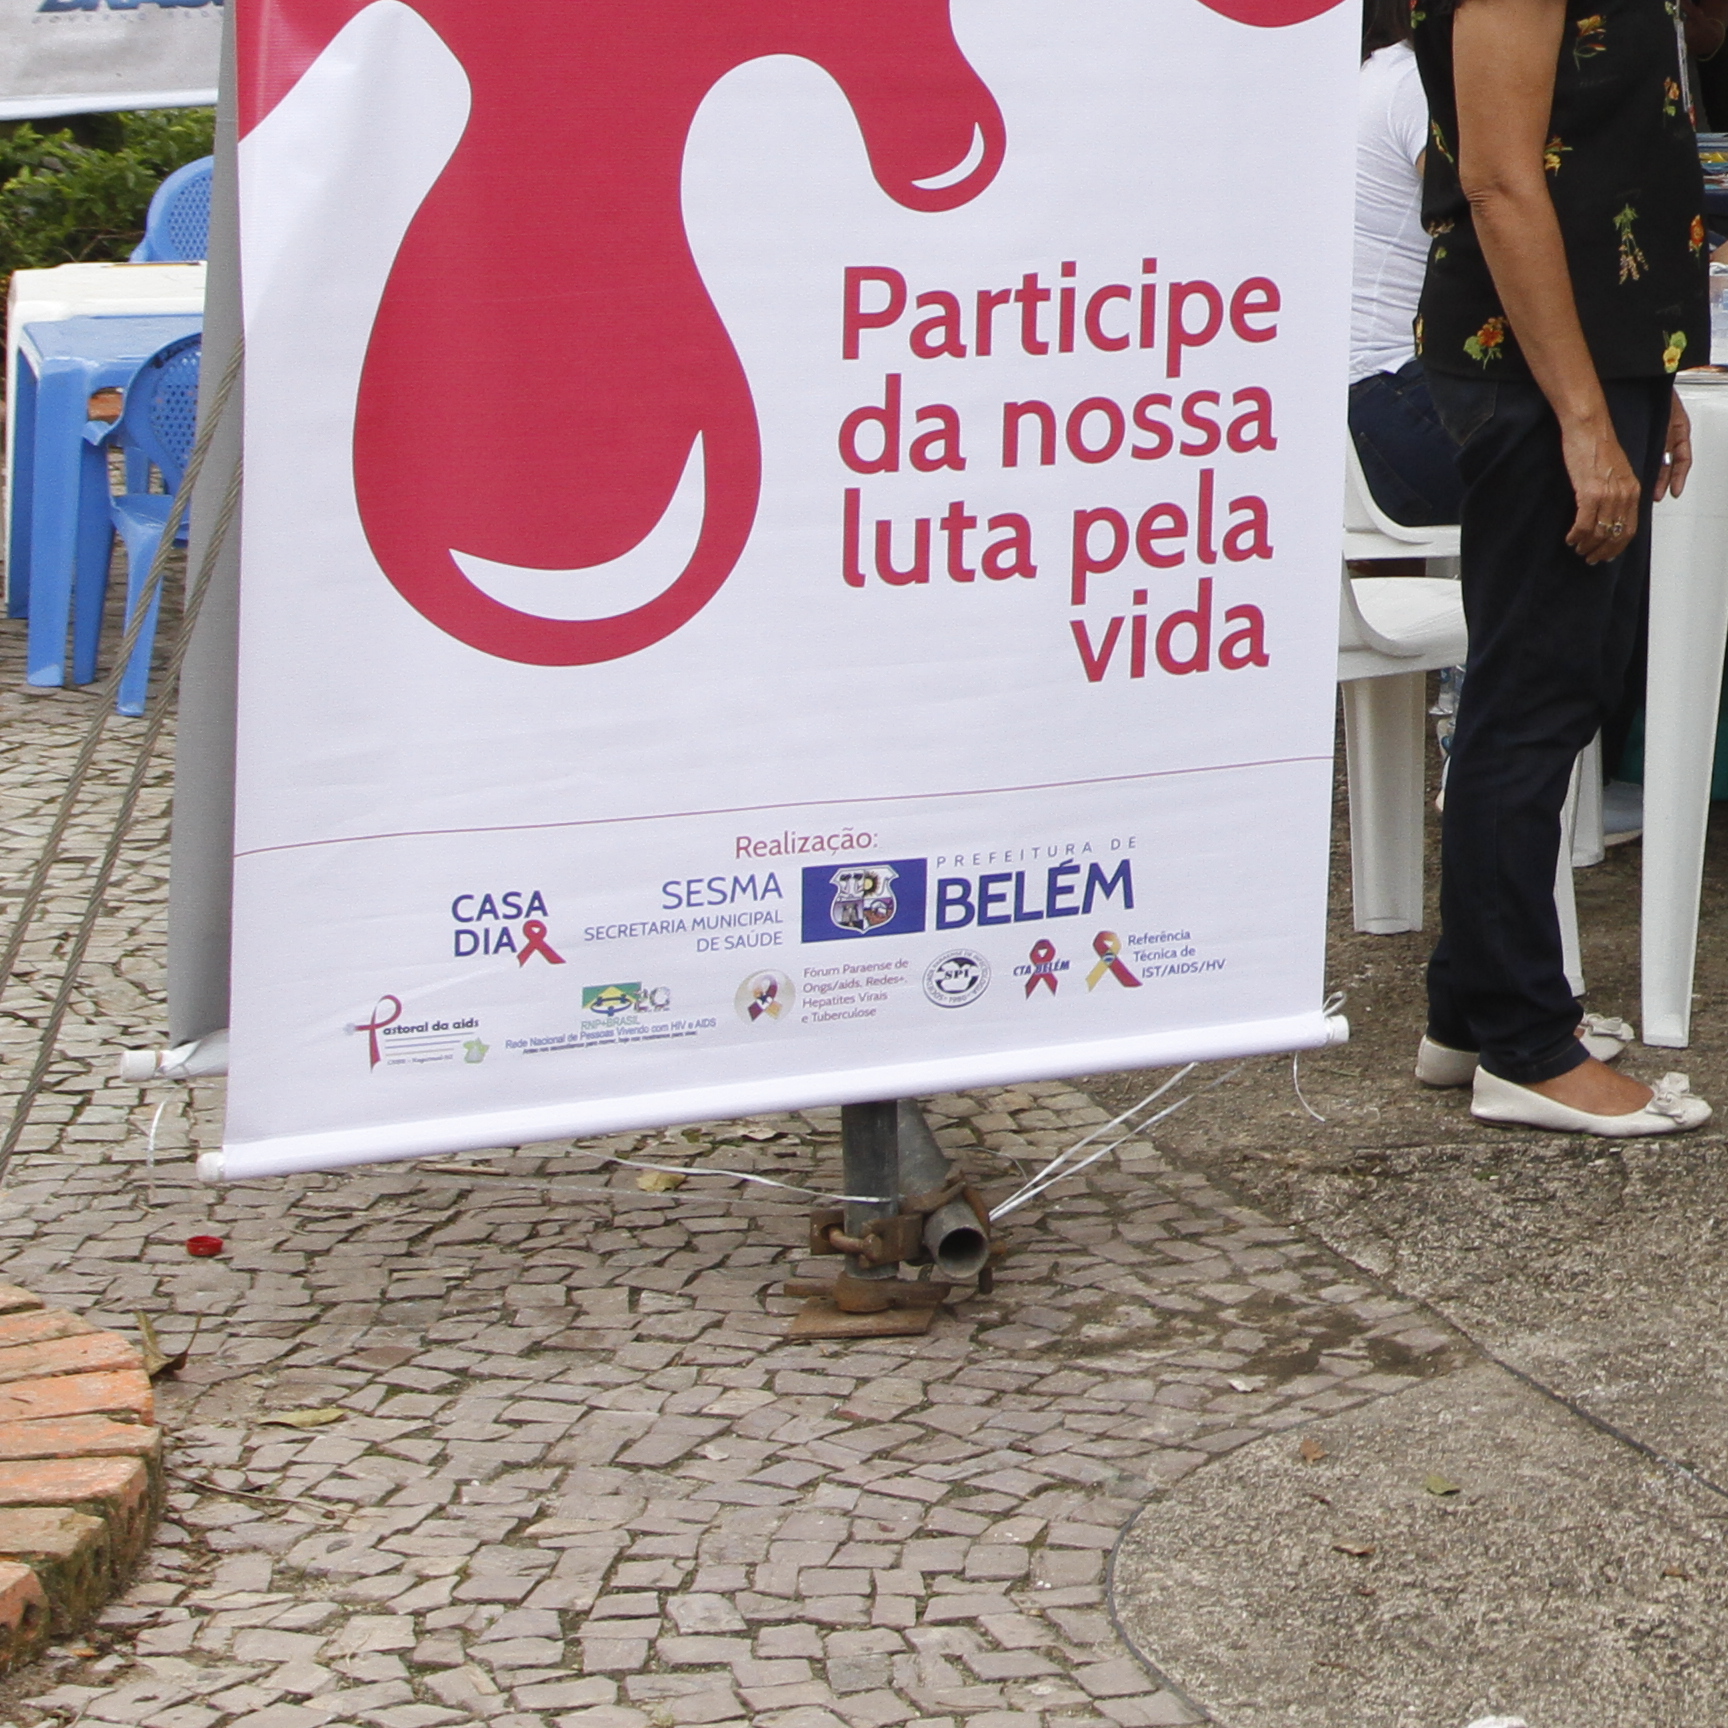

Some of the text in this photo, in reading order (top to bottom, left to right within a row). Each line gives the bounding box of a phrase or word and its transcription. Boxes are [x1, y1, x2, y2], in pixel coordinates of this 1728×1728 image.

[842, 257, 1282, 379] Participe
[838, 373, 1278, 475] da nossa
[842, 468, 1275, 606] luta pela
[1069, 576, 1270, 683] vida
[736, 826, 879, 860] Realização:
[936, 836, 1137, 869] PREFEITURA DE
[451, 890, 548, 923] CASA
[662, 871, 784, 910] SESMA
[935, 858, 1134, 931] BELÉM
[584, 909, 784, 942] SECRETARIA MUNICIPAL
[696, 929, 784, 953] DE SAÚDE
[1127, 929, 1191, 947] Referência
[453, 926, 518, 958] DIA
[1133, 945, 1196, 962] Técnica de
[803, 958, 909, 978] Fórum Paraense de
[944, 968, 970, 982] SPI
[1013, 959, 1070, 977] CTA BELÉM
[1142, 959, 1226, 979] IST/AIDS/HV
[802, 1007, 877, 1024] e Tuberculose
[803, 990, 889, 1010] Hepatites Virais
[432, 1020, 449, 1032] da
[452, 1017, 480, 1029] aids
[506, 1038, 528, 1049] Rede
[529, 1033, 565, 1047] Nacional
[567, 1033, 578, 1042] de
[580, 1028, 614, 1040] Pessoas
[617, 1025, 649, 1037] Vivendo
[651, 1024, 669, 1033] com
[671, 1020, 686, 1032] HIV
[695, 1017, 717, 1029] AIDS
[581, 1015, 640, 1031] RNP+BRASIL
